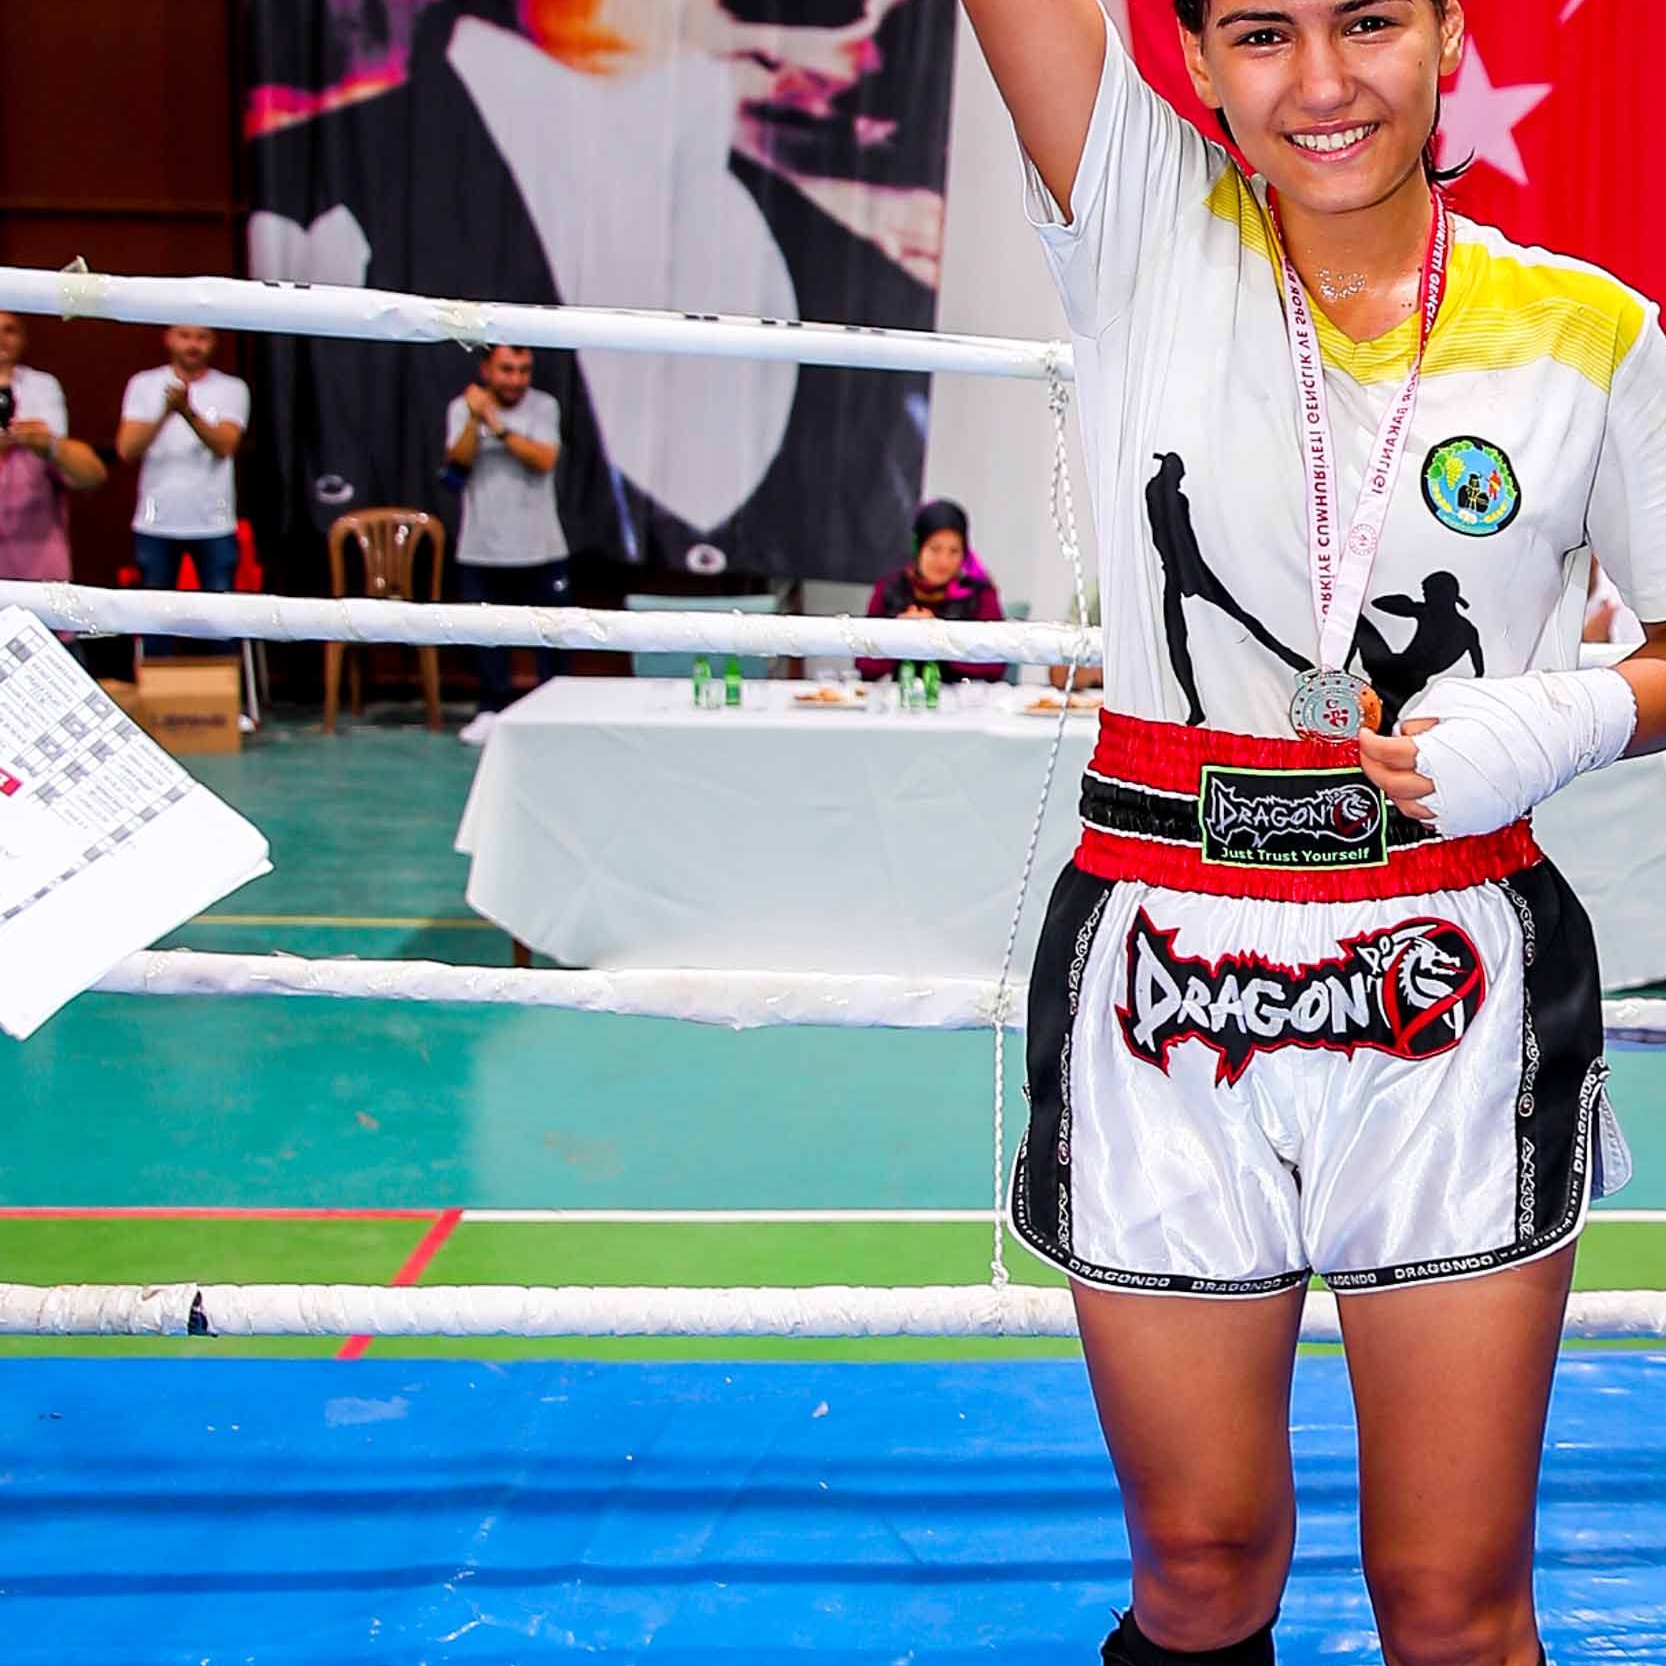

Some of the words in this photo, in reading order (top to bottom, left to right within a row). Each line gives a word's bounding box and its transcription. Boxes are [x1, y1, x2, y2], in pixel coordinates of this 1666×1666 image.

[1215, 790, 1327, 834] DRAGON
[1221, 847, 1255, 860] Just
[1257, 849, 1299, 862] Trust
[1302, 847, 1371, 863] Yourself
[1132, 931, 1371, 1053] DRAGON
[1068, 1258, 1171, 1288] DRAGONDO
[1191, 1278, 1283, 1293] DRAGONDO
[1394, 1253, 1494, 1280] DRAGONDO
